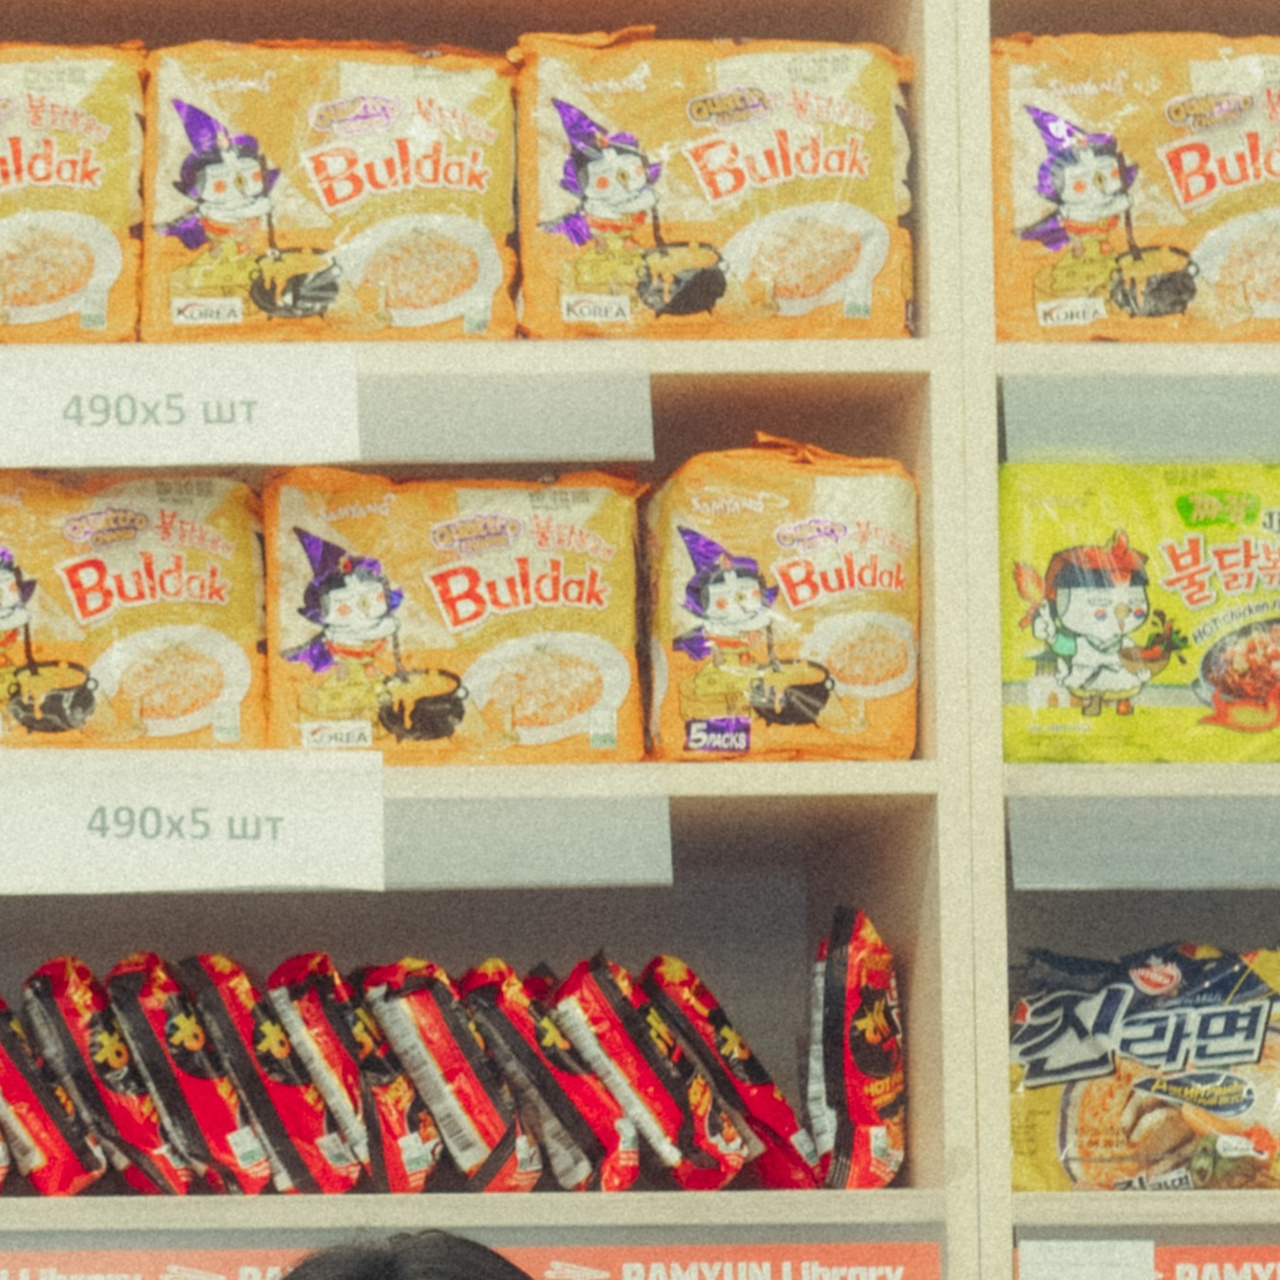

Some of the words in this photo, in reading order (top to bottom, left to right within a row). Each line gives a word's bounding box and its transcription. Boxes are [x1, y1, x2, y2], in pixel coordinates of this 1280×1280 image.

[308, 138, 489, 208] Buldak
[689, 133, 871, 201] Buldak
[173, 304, 240, 322] KOREA
[565, 302, 629, 321] KOREA
[1042, 305, 1104, 324] KOREA
[62, 393, 185, 427] 490x5
[202, 400, 259, 426] шт
[64, 550, 226, 620] Buldak
[431, 557, 608, 627] Buldak
[776, 553, 906, 608] Buldak
[310, 727, 369, 745] KOREA
[86, 804, 213, 841] 490x5
[227, 813, 284, 842] шт
